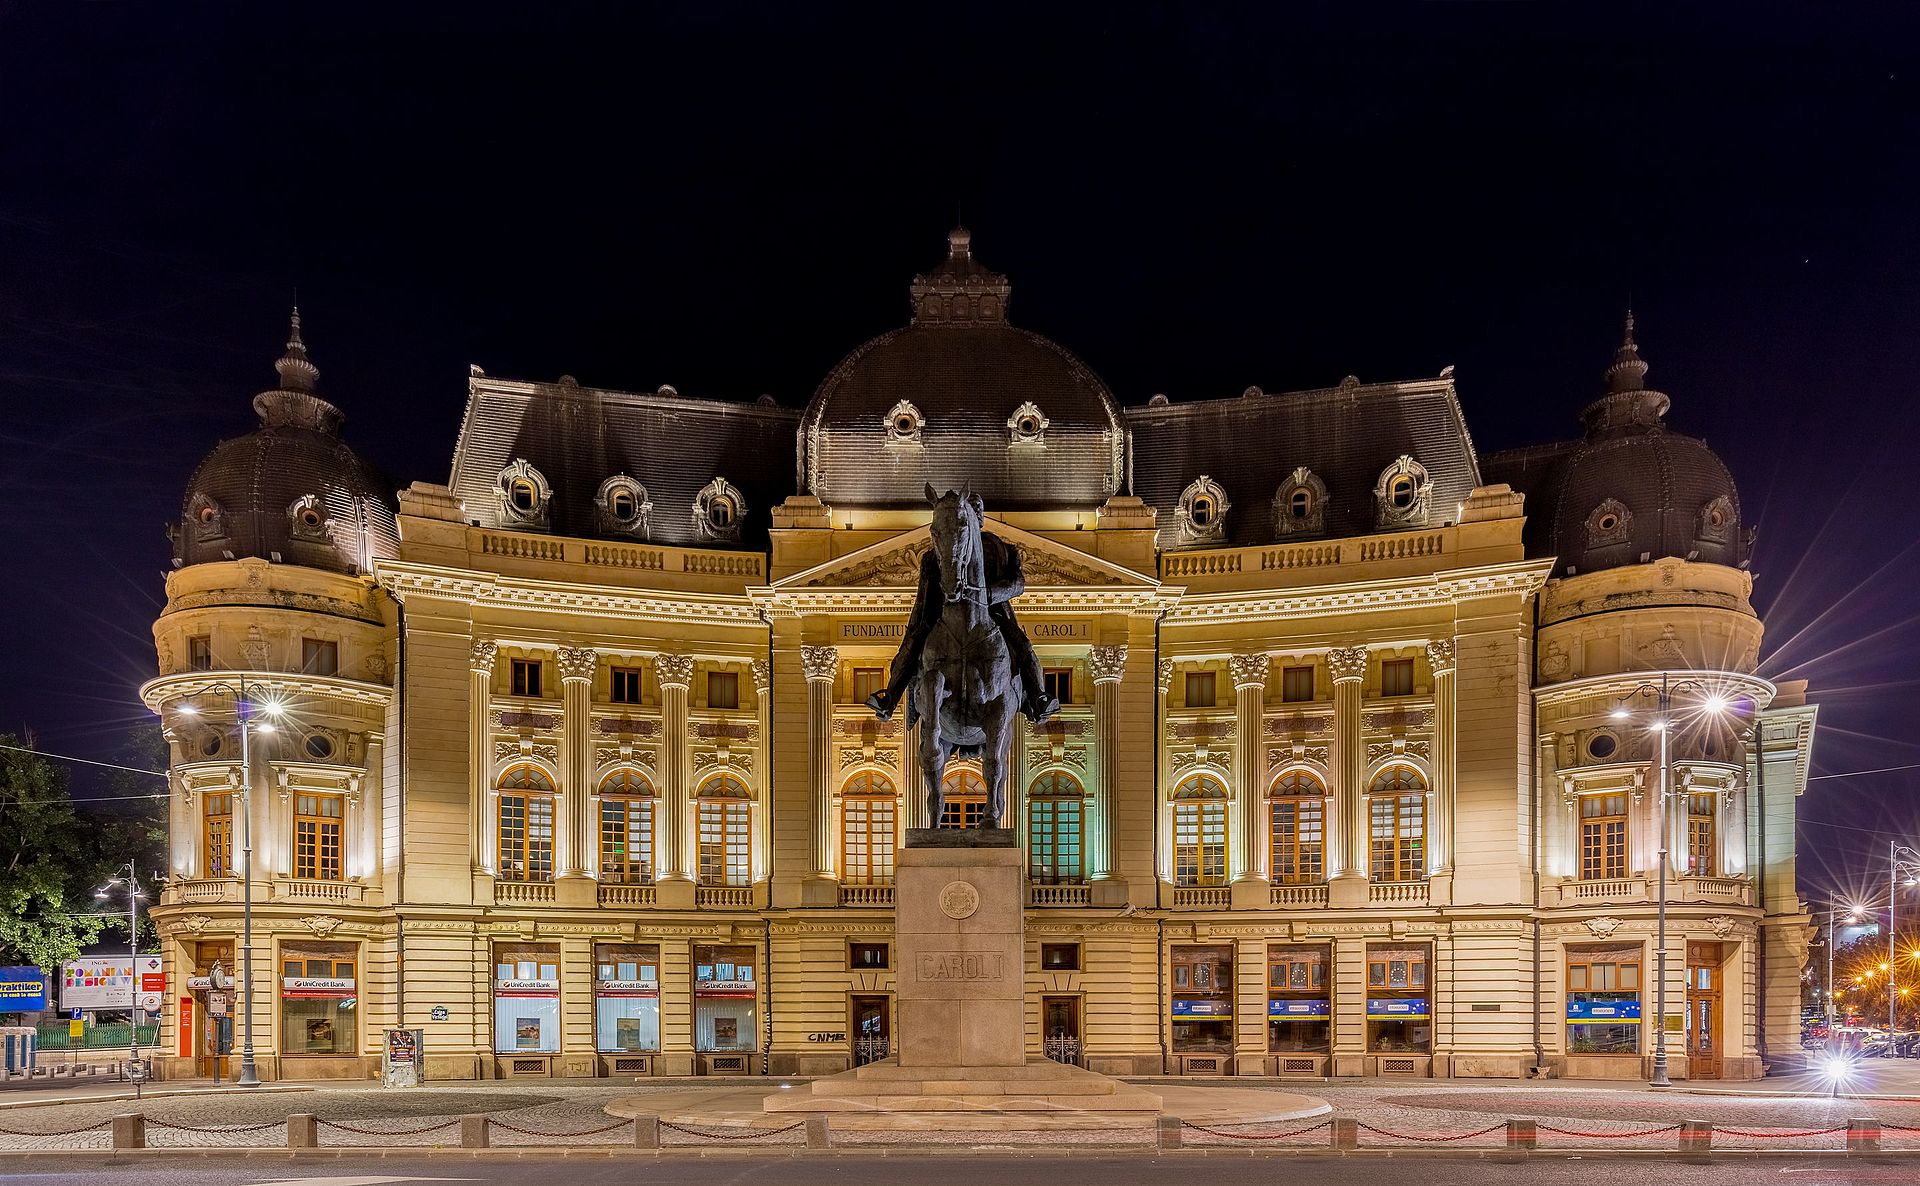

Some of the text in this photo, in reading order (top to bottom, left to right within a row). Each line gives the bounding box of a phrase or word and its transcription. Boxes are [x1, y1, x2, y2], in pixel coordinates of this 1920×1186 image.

[1034, 624, 1077, 637] CAROL
[1082, 624, 1087, 637] I
[923, 954, 1002, 979] CAROL I
[66, 967, 132, 978] ROMANIAN
[66, 976, 117, 987] DESIGN
[74, 1008, 80, 1019] P
